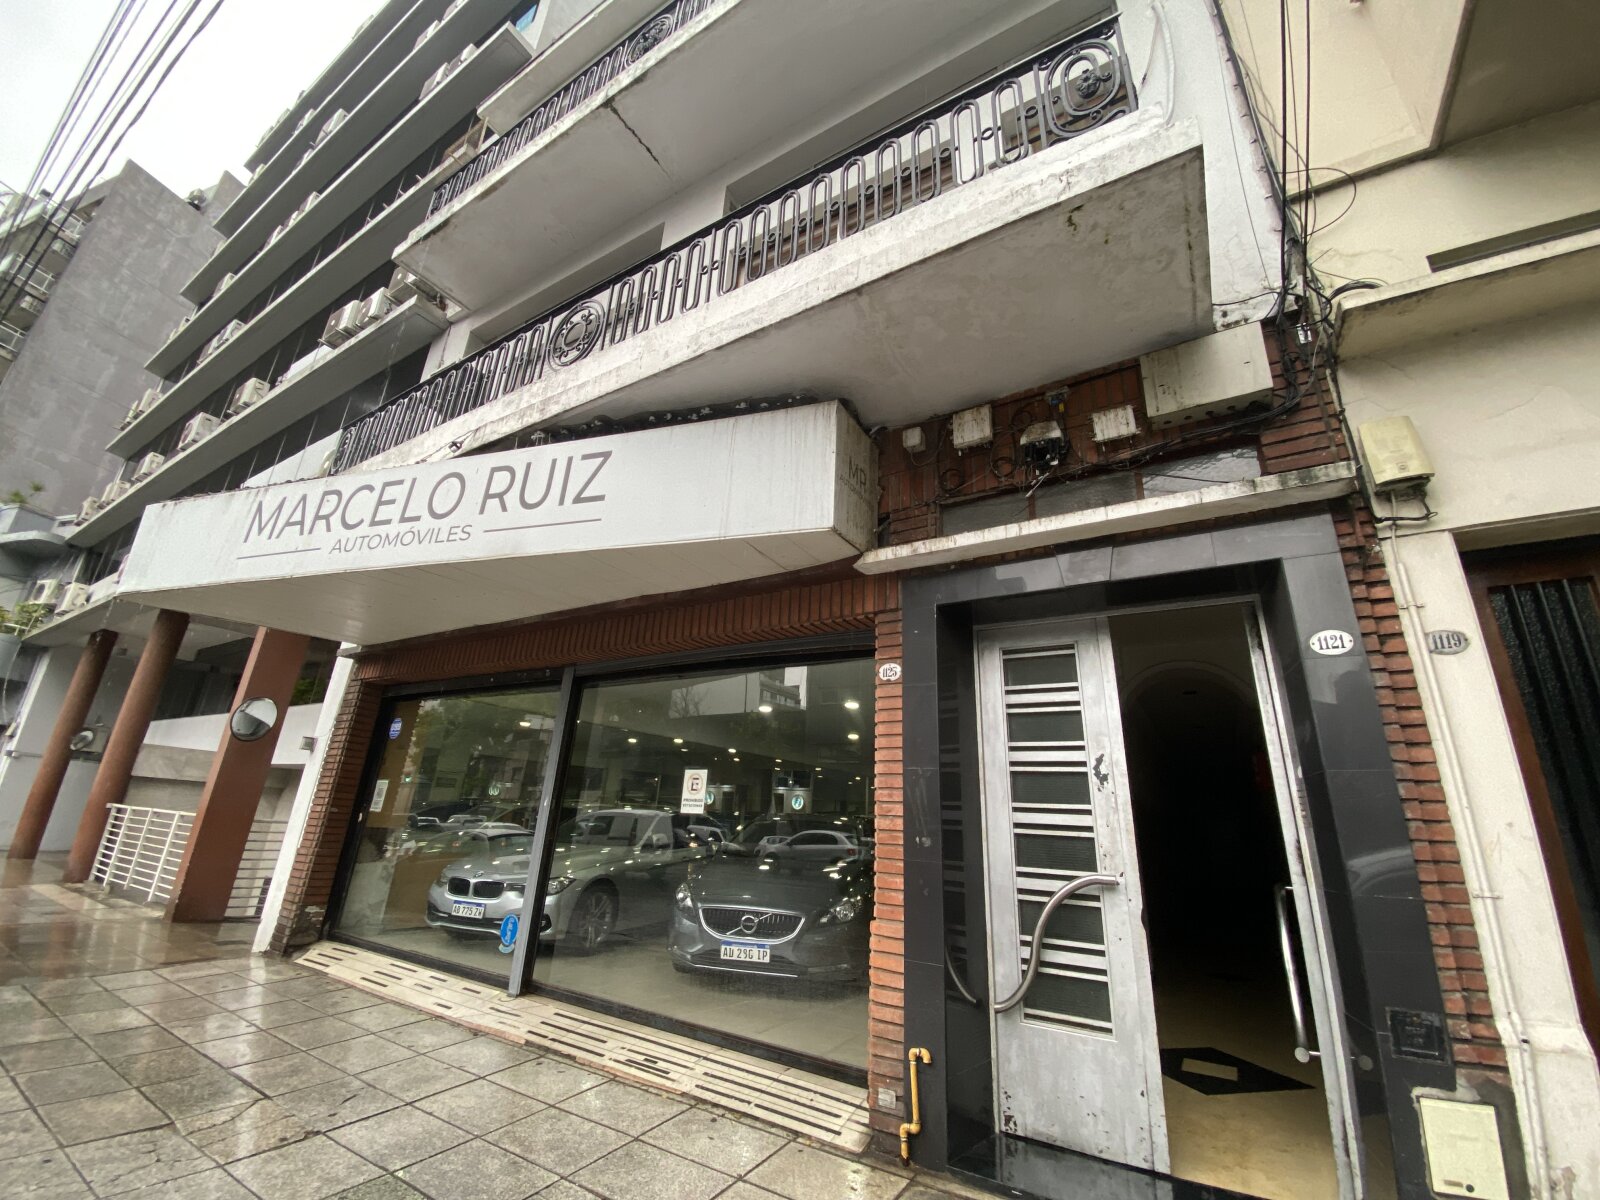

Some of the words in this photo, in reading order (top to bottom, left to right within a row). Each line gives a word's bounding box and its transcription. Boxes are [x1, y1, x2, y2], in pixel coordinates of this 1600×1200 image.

[243, 471, 466, 543] MARCELO
[478, 450, 613, 515] RUIZ
[328, 525, 473, 555] AUTOMÓVILES
[1317, 634, 1347, 651] 1121
[1432, 632, 1462, 650] 1119
[882, 666, 898, 679] 1125
[461, 906, 472, 915] 775
